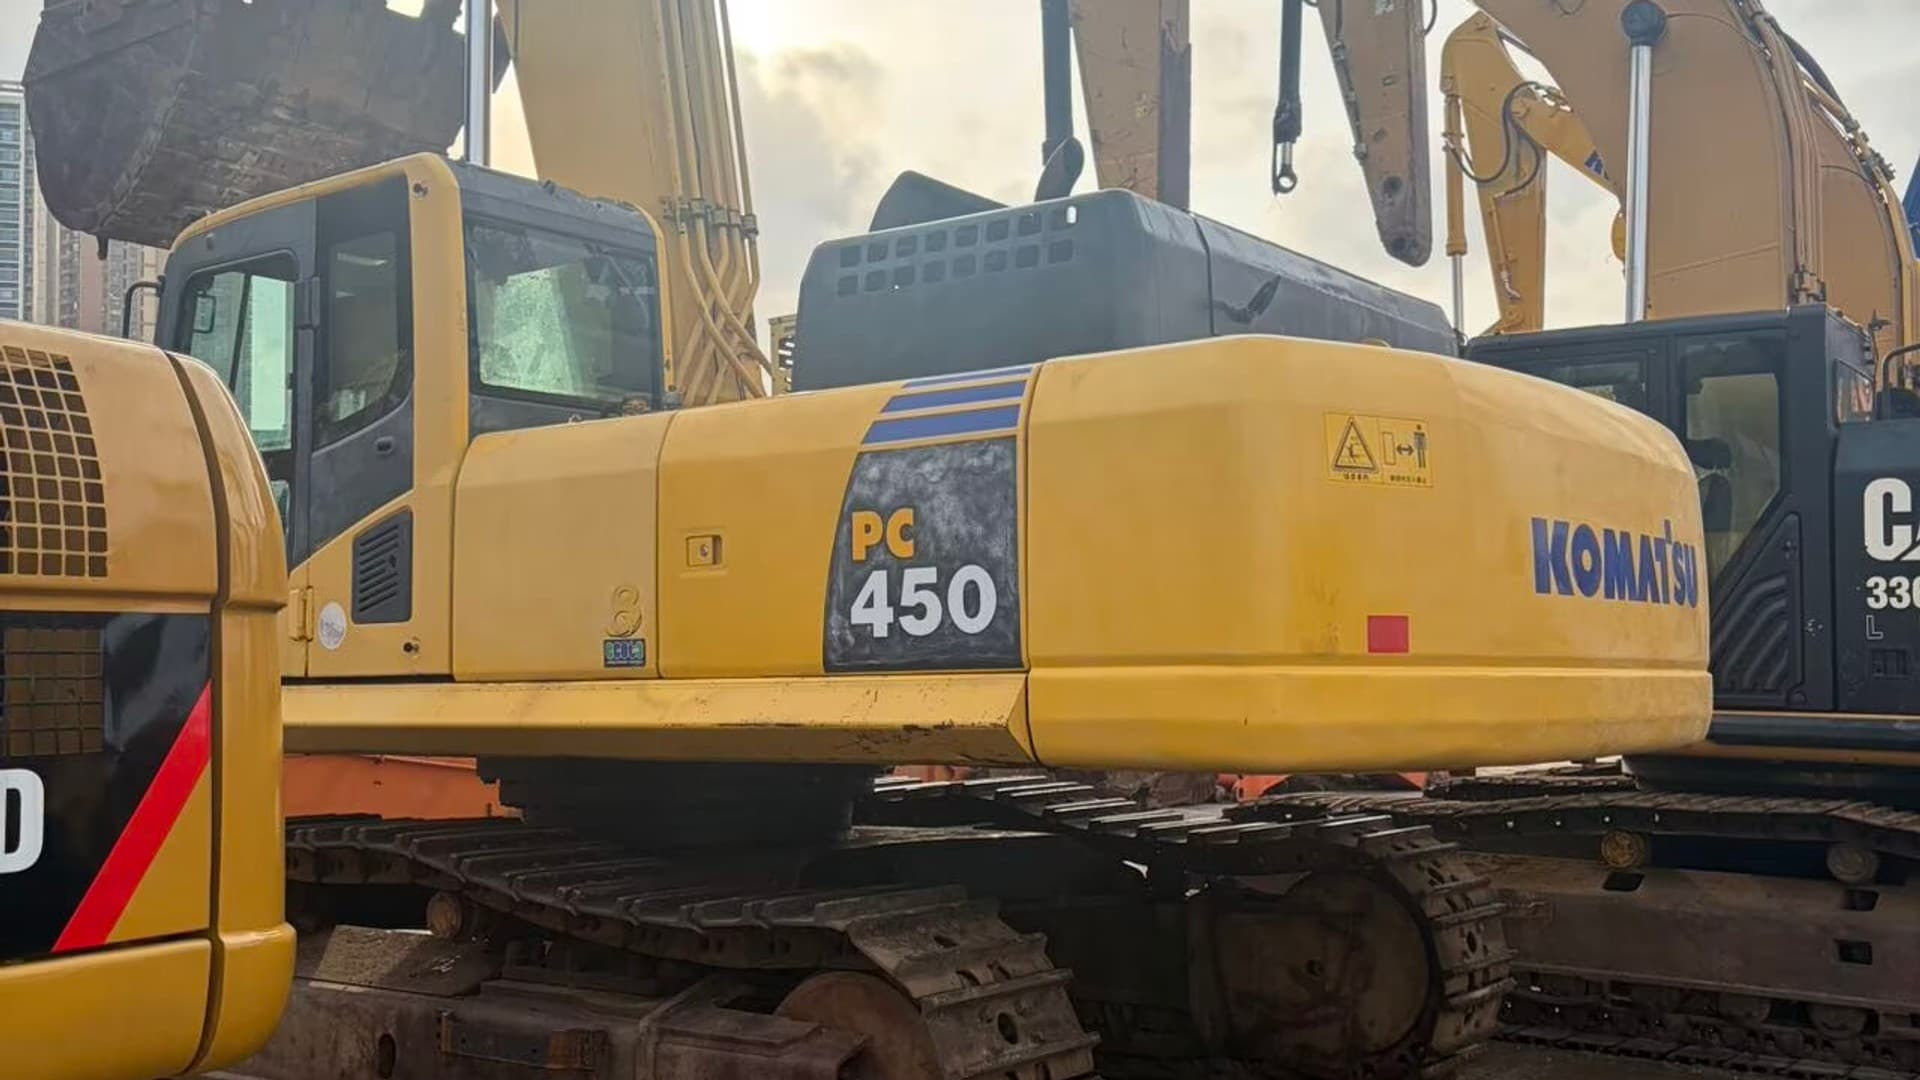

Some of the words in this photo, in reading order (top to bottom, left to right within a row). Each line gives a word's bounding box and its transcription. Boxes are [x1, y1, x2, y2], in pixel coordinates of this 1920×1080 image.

[852, 508, 914, 560] PC
[1531, 517, 1698, 608] KOMATSU
[851, 564, 997, 638] 450
[1866, 614, 1884, 640] L
[0, 768, 45, 873] D
